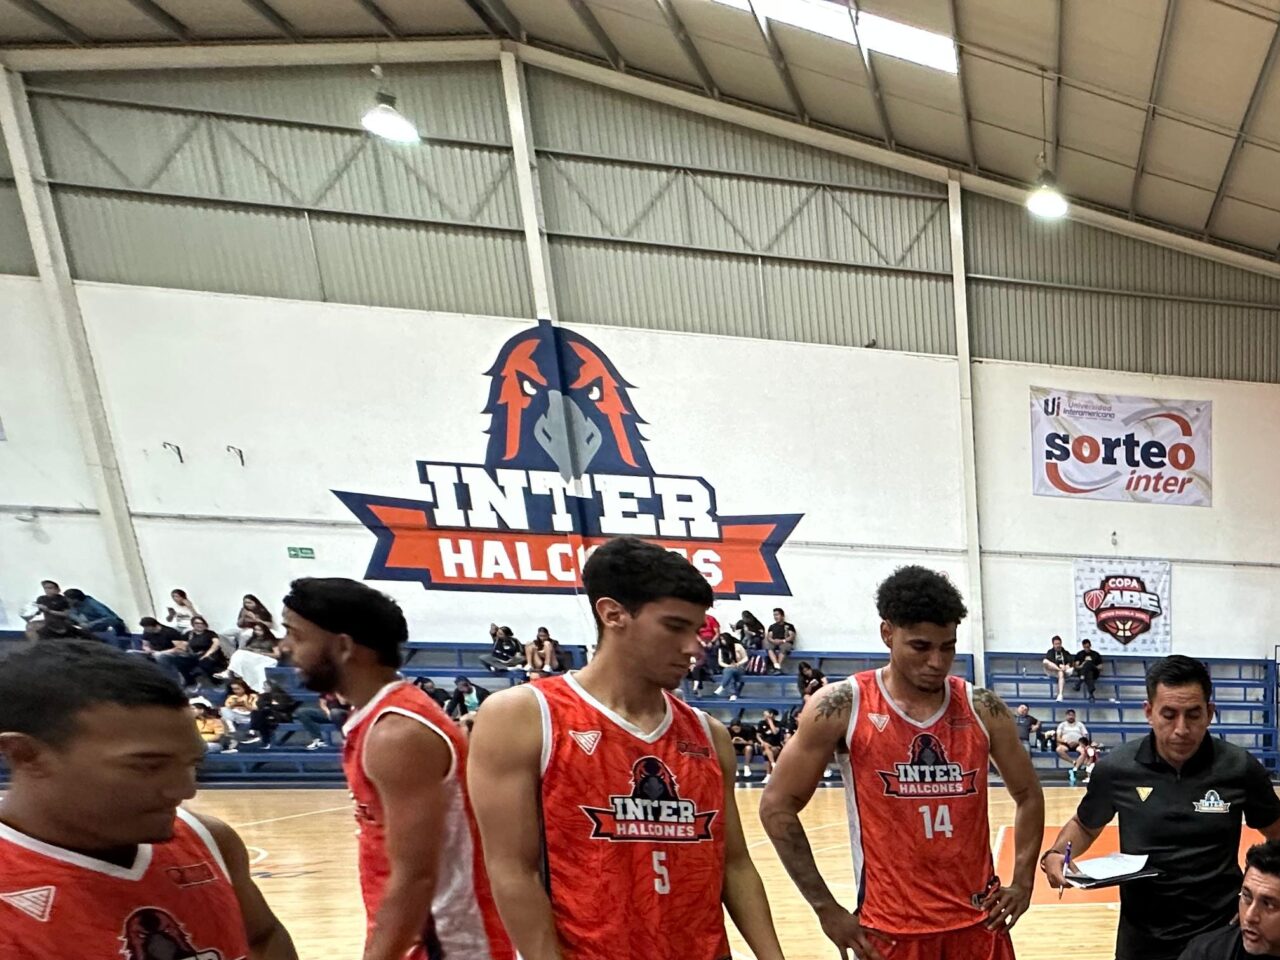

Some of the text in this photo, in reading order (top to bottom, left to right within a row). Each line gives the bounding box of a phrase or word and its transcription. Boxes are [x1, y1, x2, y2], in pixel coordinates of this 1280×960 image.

[1045, 432, 1195, 470] sorteo
[1125, 469, 1193, 494] inter
[424, 463, 720, 539] INTER
[438, 538, 724, 585] HALCS
[1108, 577, 1139, 588] COPA
[1100, 589, 1161, 614] ABE
[897, 764, 962, 782] INTER
[900, 783, 963, 794] HALCONES
[613, 798, 695, 823] INTER
[918, 805, 953, 839] 14
[616, 823, 695, 837] HALCONES
[652, 851, 671, 895] 5
